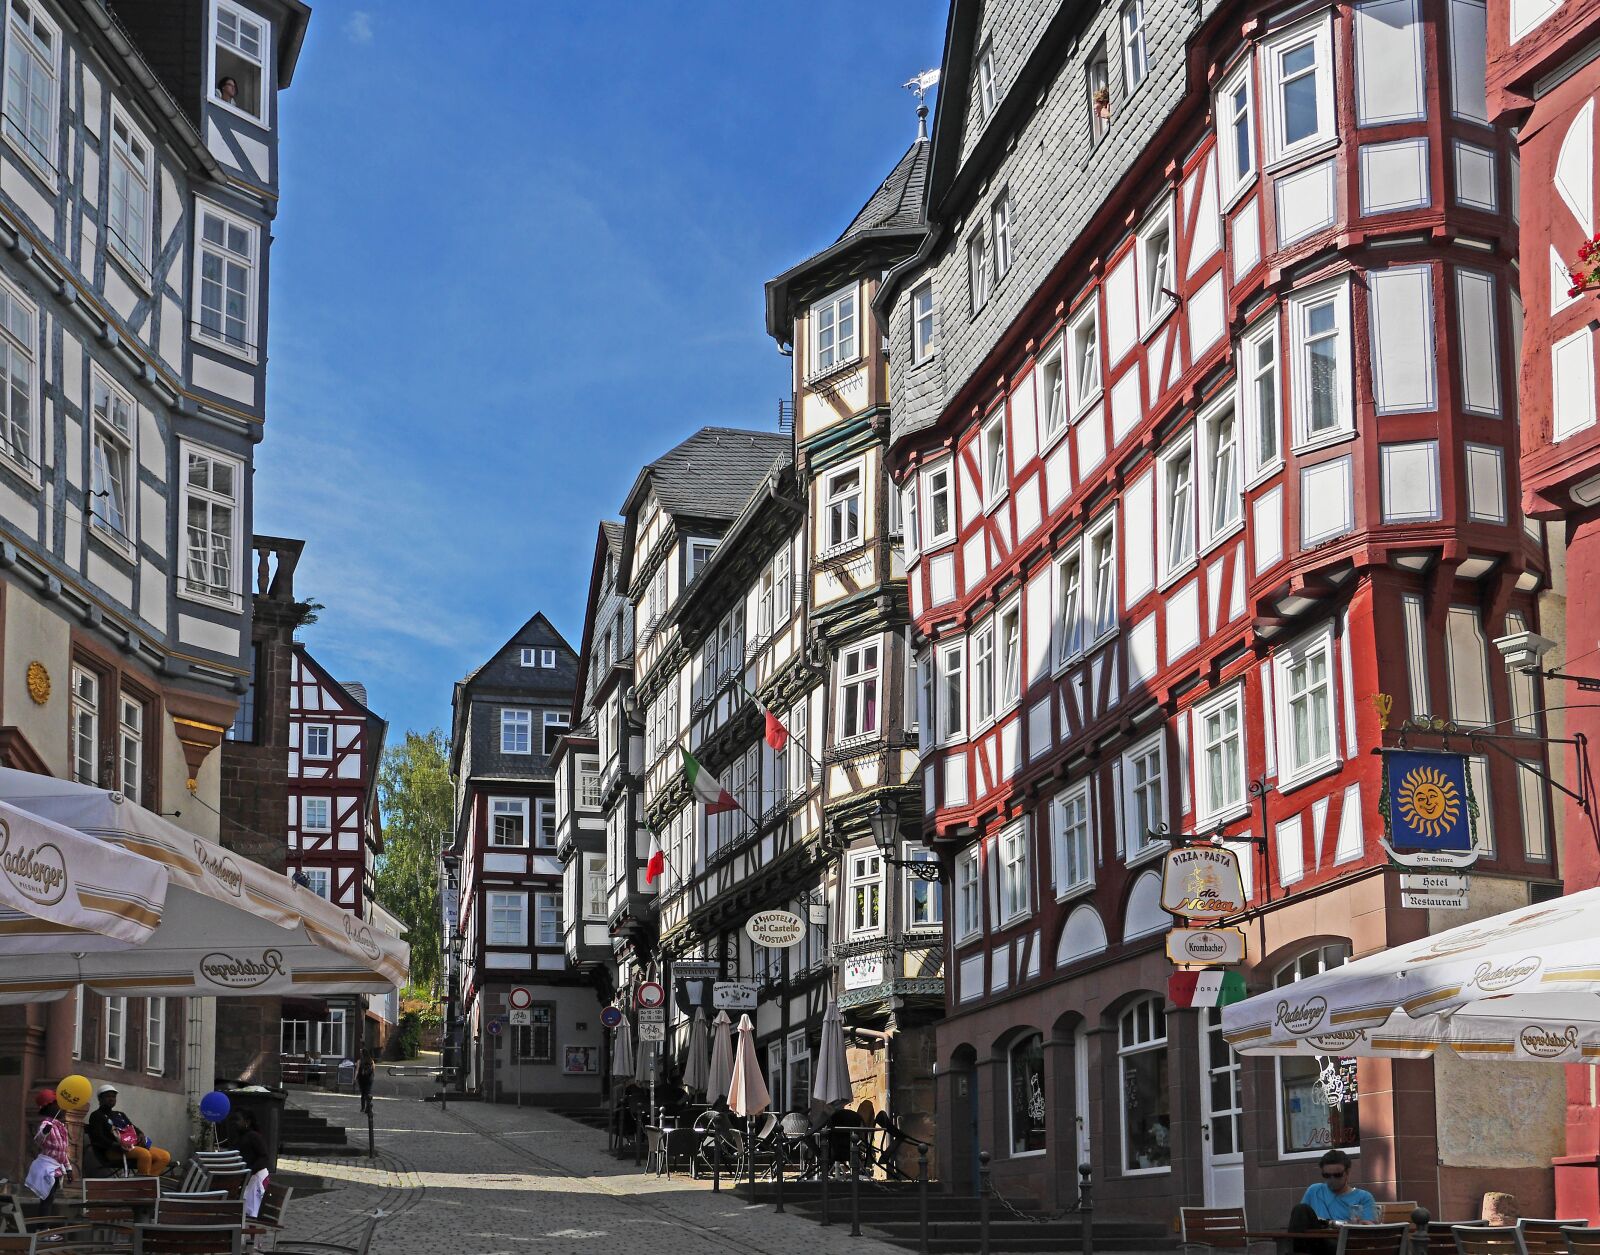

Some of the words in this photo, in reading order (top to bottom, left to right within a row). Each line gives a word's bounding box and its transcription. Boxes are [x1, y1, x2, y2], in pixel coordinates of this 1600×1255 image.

[1172, 851, 1199, 867] PIZZA
[1204, 851, 1231, 867] PASTA
[19, 881, 43, 895] PILSNER
[1422, 877, 1449, 888] Hotel
[1199, 888, 1219, 898] da
[1169, 897, 1238, 912] Nella
[1410, 896, 1462, 907] Restaurant
[761, 914, 789, 923] HOTEL
[752, 924, 767, 932] Del
[768, 924, 801, 933] Castello
[758, 933, 797, 944] HOSTARIA
[1188, 943, 1224, 952] Krombacher
[1467, 958, 1539, 988] Radeberger
[1275, 997, 1326, 1027] Radeberger
